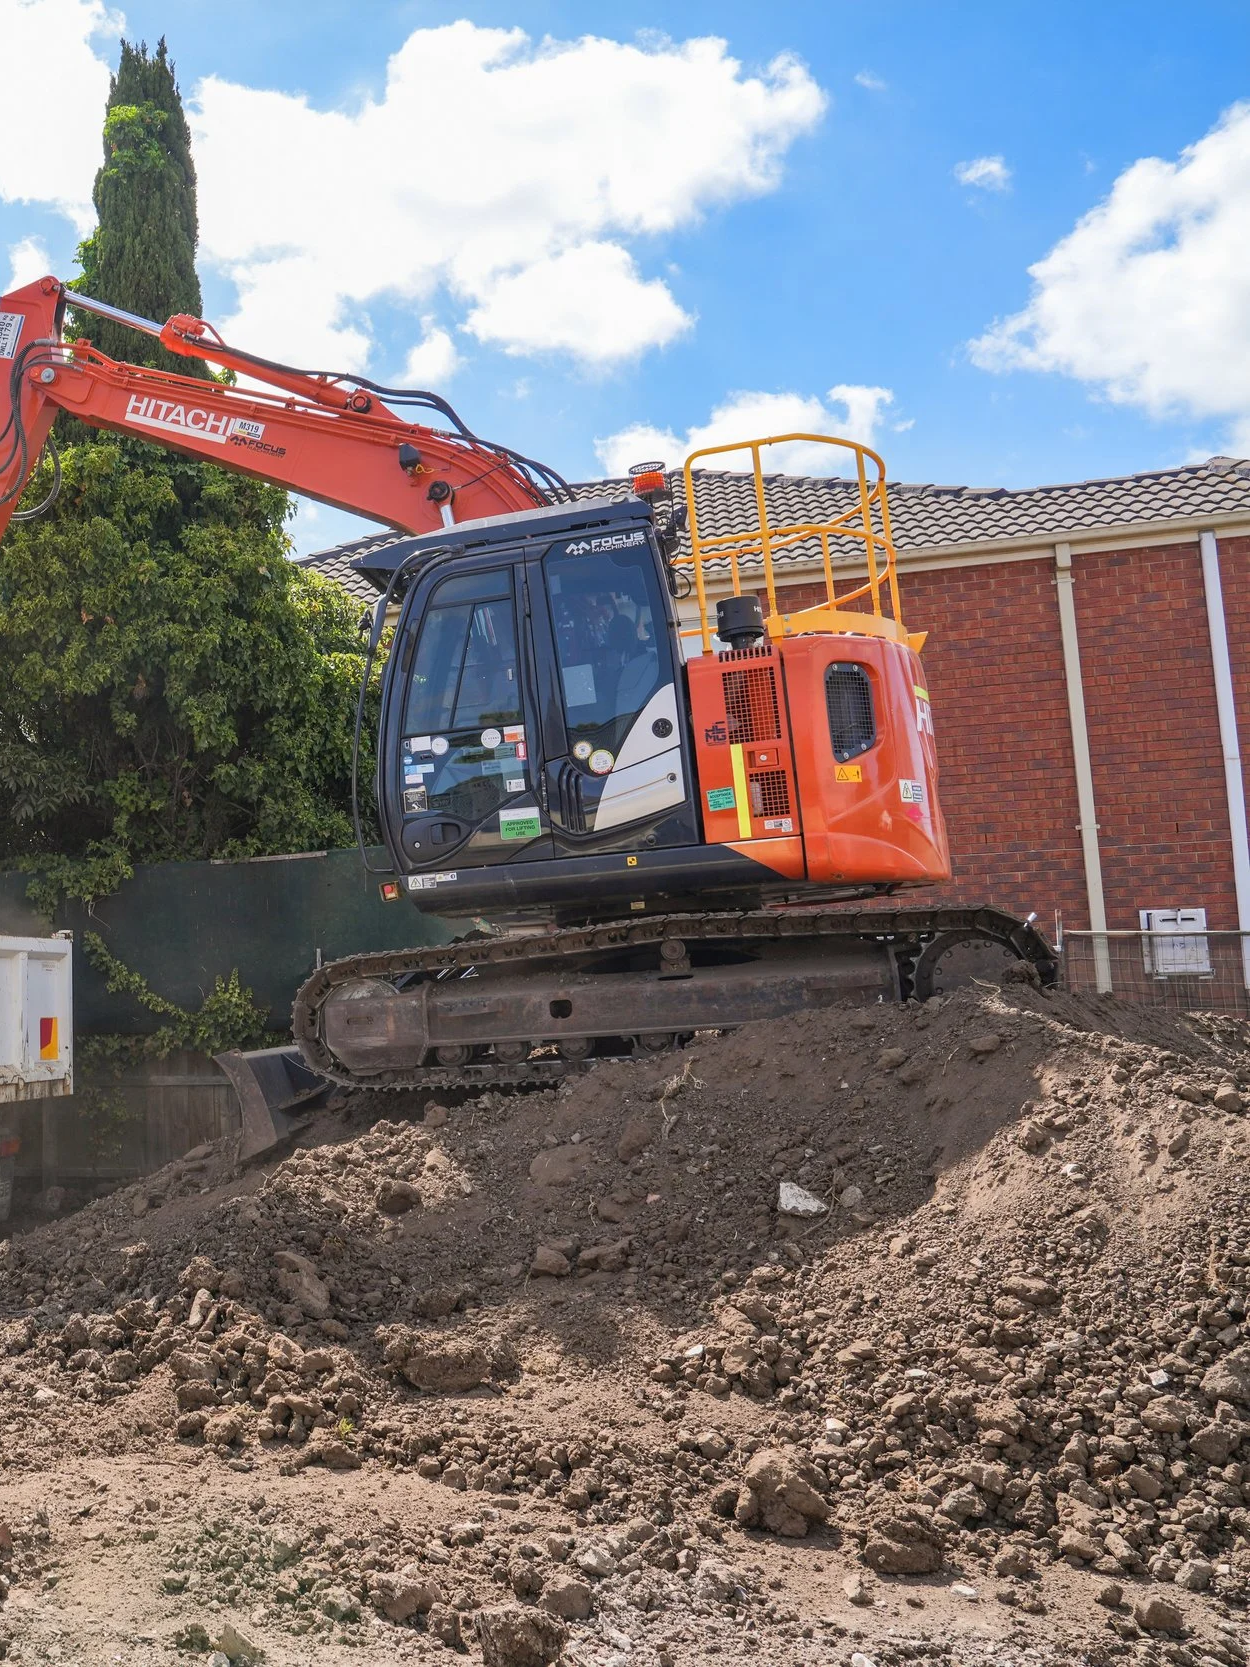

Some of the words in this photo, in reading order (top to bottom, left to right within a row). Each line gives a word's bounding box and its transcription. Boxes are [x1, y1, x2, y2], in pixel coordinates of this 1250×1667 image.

[126, 394, 236, 436] HITACHI
[239, 421, 260, 434] M319
[248, 439, 287, 455] FOCUS
[591, 531, 645, 549] FOCUS
[592, 540, 646, 553] MACHINERY
